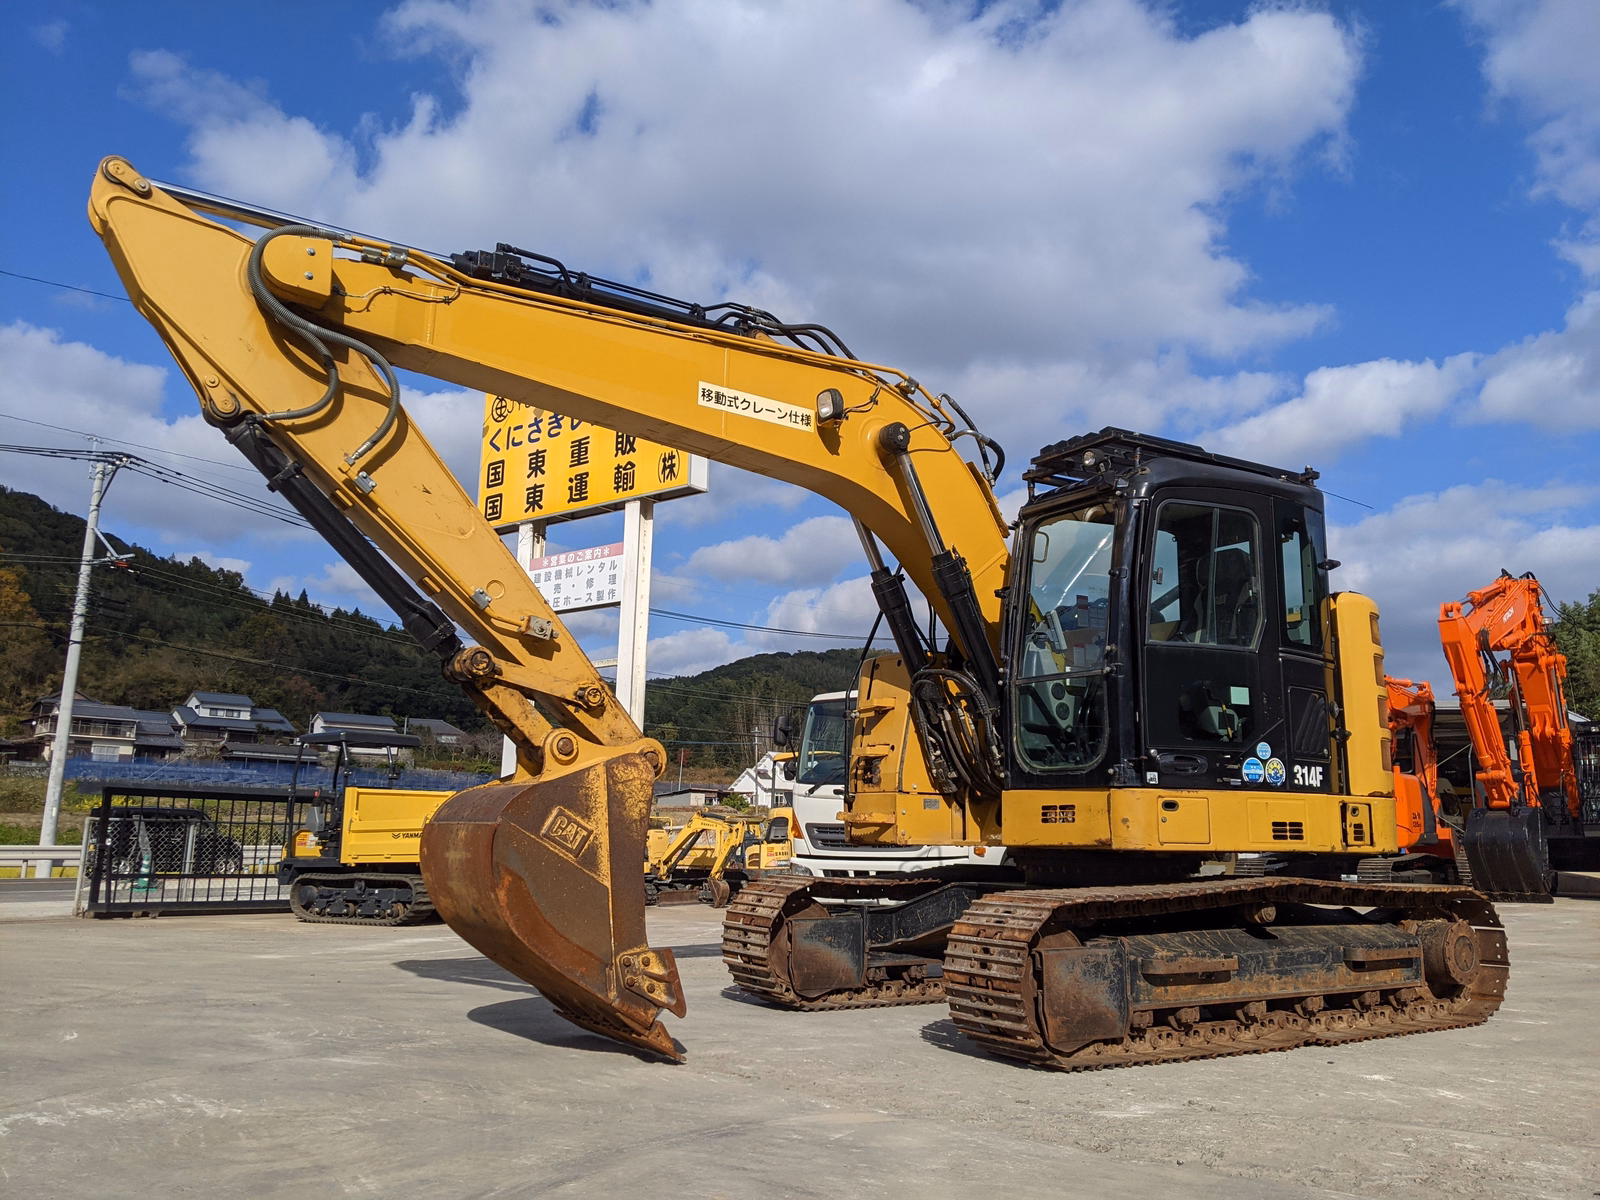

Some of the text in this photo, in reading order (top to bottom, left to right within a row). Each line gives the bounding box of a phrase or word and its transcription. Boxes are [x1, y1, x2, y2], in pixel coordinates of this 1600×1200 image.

[701, 388, 811, 427] 移動式クレーン仕様
[489, 412, 584, 452] くにさきレ
[534, 560, 618, 584] 建設機械レンタル
[1293, 764, 1323, 788] 314F
[549, 815, 588, 850] CAT
